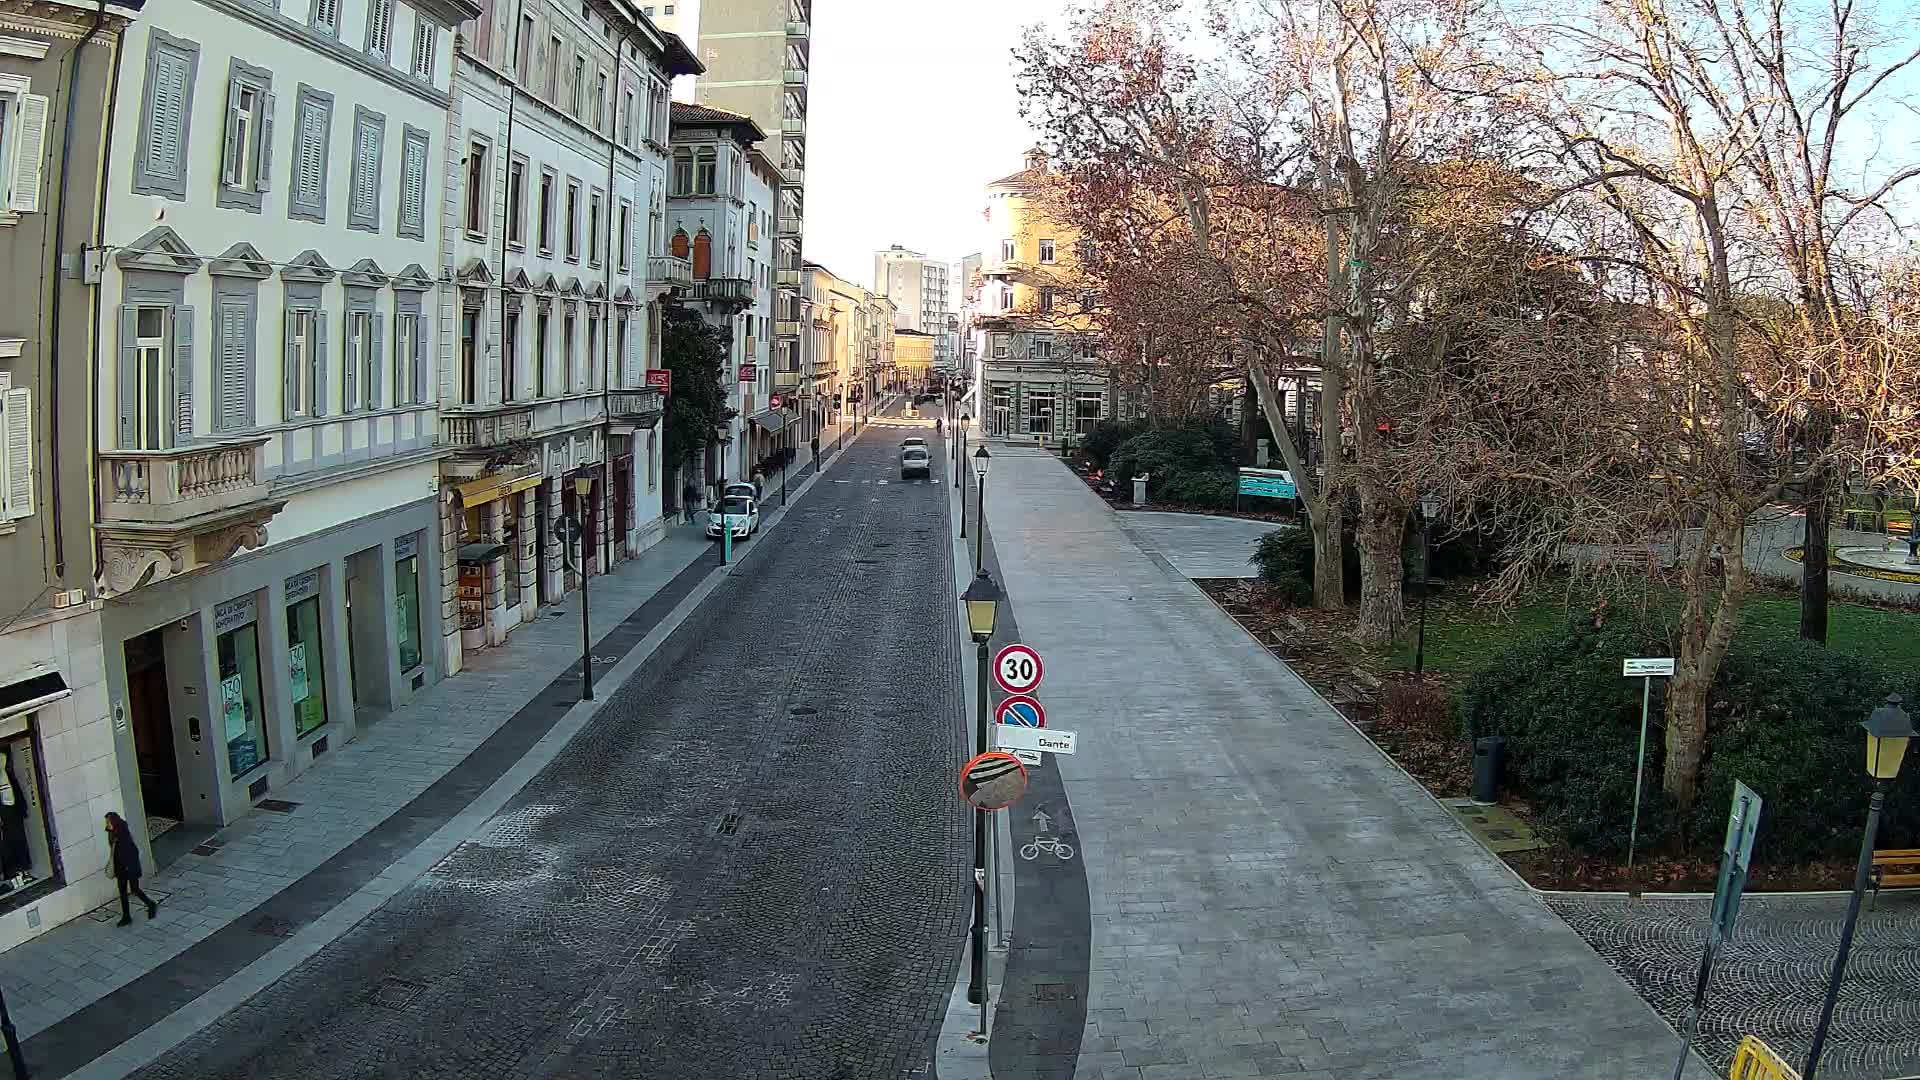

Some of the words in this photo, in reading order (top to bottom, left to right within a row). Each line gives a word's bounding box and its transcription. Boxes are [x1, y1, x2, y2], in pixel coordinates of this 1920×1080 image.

[1006, 659, 1032, 680] 30
[223, 677, 240, 699] 130
[1039, 738, 1070, 749] Dante
